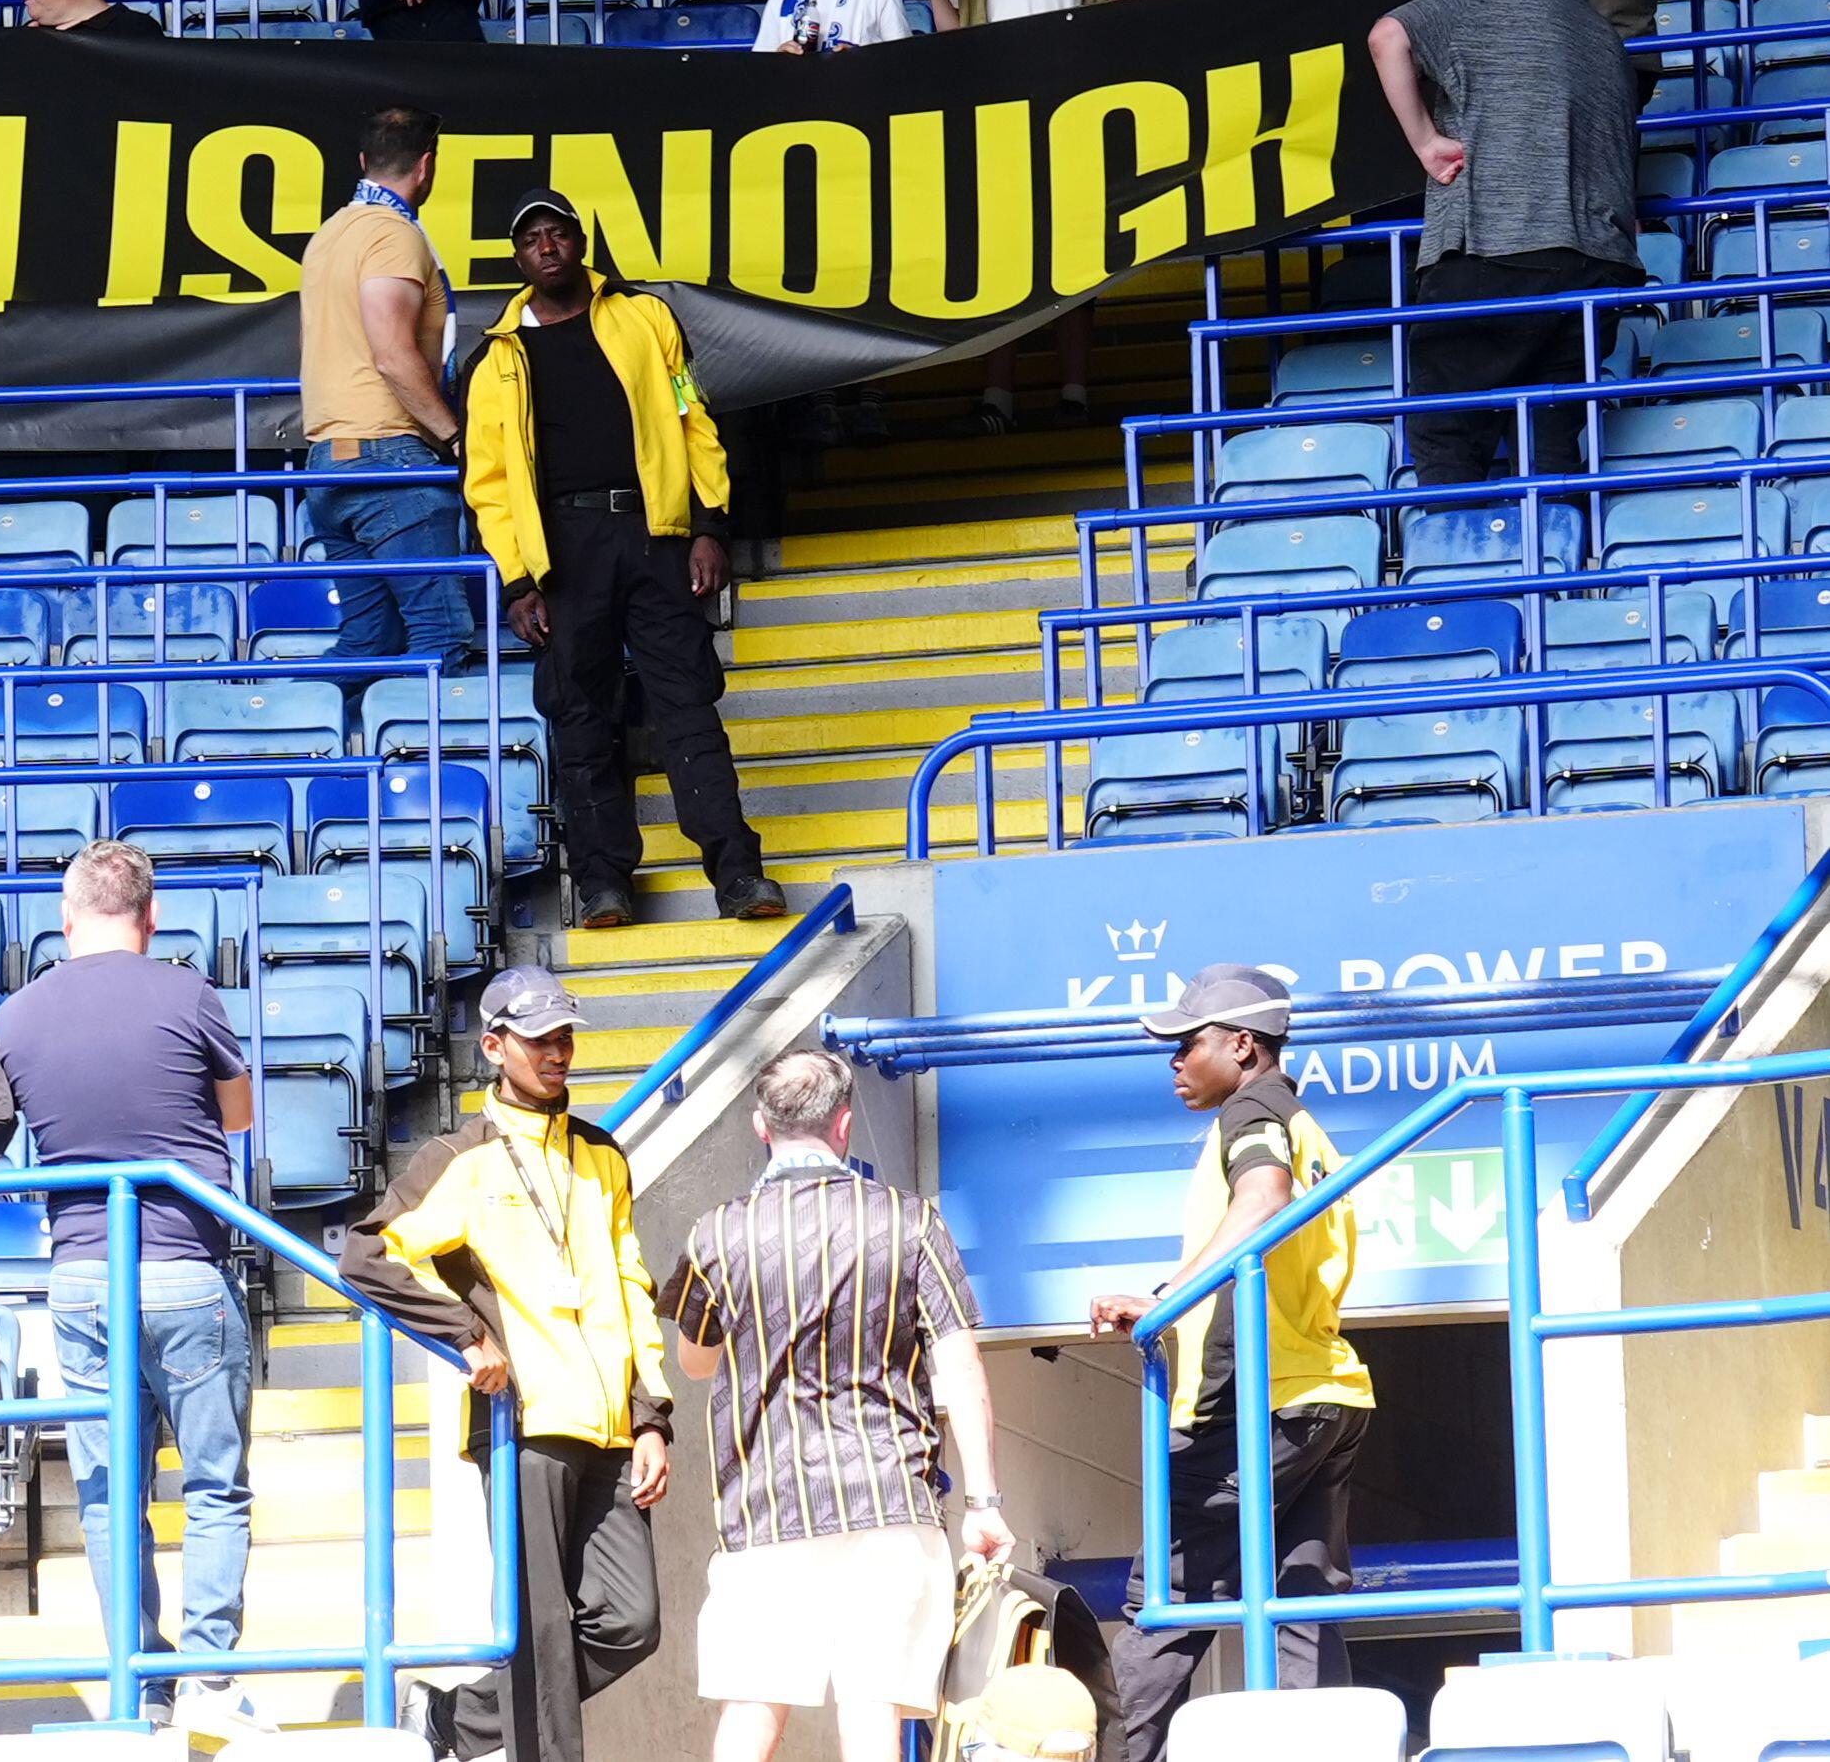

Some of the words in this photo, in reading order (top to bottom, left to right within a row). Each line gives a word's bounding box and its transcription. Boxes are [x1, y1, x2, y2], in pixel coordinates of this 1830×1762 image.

[98, 121, 324, 307] IS
[426, 43, 1344, 320] ENOUGH
[1279, 1039, 1497, 1095] TADIUM
